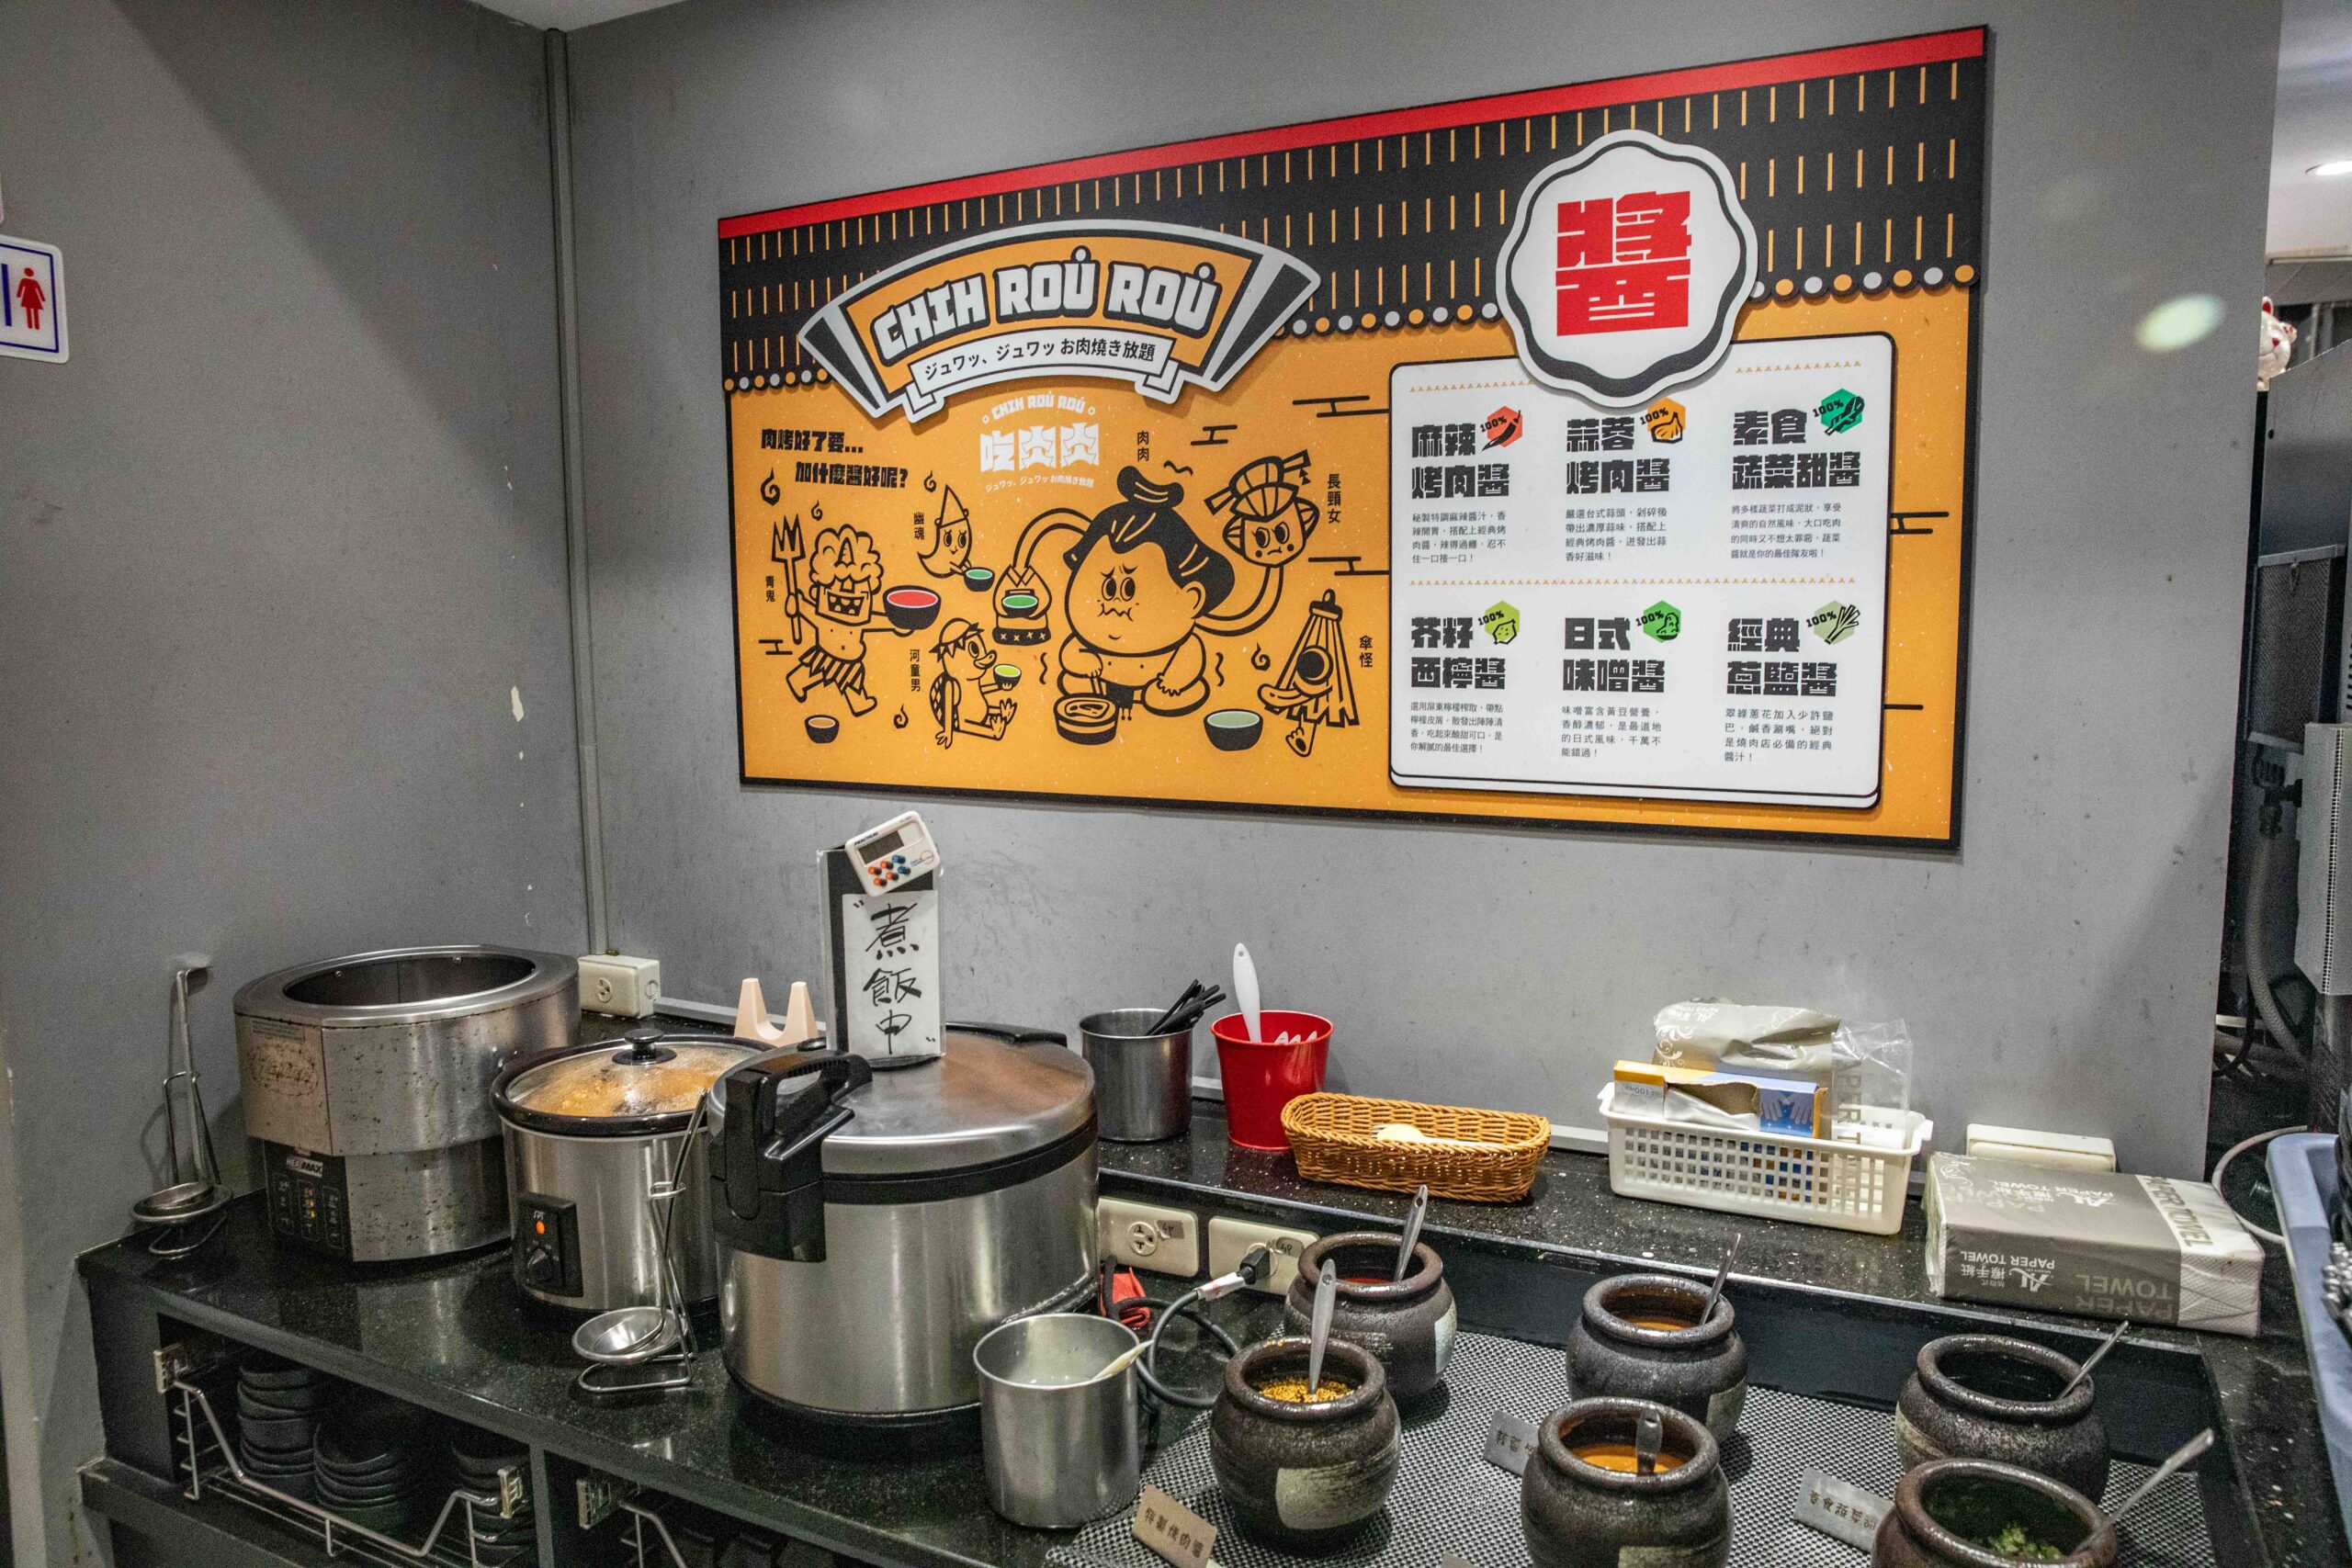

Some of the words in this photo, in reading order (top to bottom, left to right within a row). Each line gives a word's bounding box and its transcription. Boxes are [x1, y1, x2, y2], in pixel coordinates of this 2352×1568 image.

[872, 274, 989, 363] CHIH
[991, 397, 1024, 420] CHIH
[1480, 415, 1507, 433] 100%
[1640, 408, 1668, 424] 100%
[1813, 399, 1844, 417] 100%
[1412, 423, 1476, 457] 麻辣
[1566, 416, 1634, 452] 蒜蓉
[1734, 409, 1807, 446] 素食
[1137, 430, 1149, 462] 肉肉
[1411, 463, 1510, 499] 烤肉醬
[1566, 457, 1670, 494] 烤肉醬
[1732, 451, 1860, 490] 蔬菜甜醬
[1327, 473, 1341, 524] 長頸女
[914, 511, 924, 540] 幽魂
[764, 575, 776, 603] 青鬼
[1477, 610, 1505, 626] 100%
[1565, 617, 1631, 650] 日式
[1636, 610, 1664, 626] 100%
[1805, 611, 1837, 627] 100%
[1727, 617, 1801, 652] 經典
[1359, 635, 1374, 668] 傘怪
[910, 649, 922, 692] 河童男
[1411, 657, 1506, 689] 西檸醬
[1563, 659, 1665, 693] 味噌醬
[2054, 1185, 2114, 1198] PAPER
[1960, 1250, 2007, 1265] TOWEL
[1961, 1264, 2006, 1280] 擦手紙
[2010, 1255, 2055, 1269] PAPER
[2075, 1274, 2174, 1300] TOWEL
